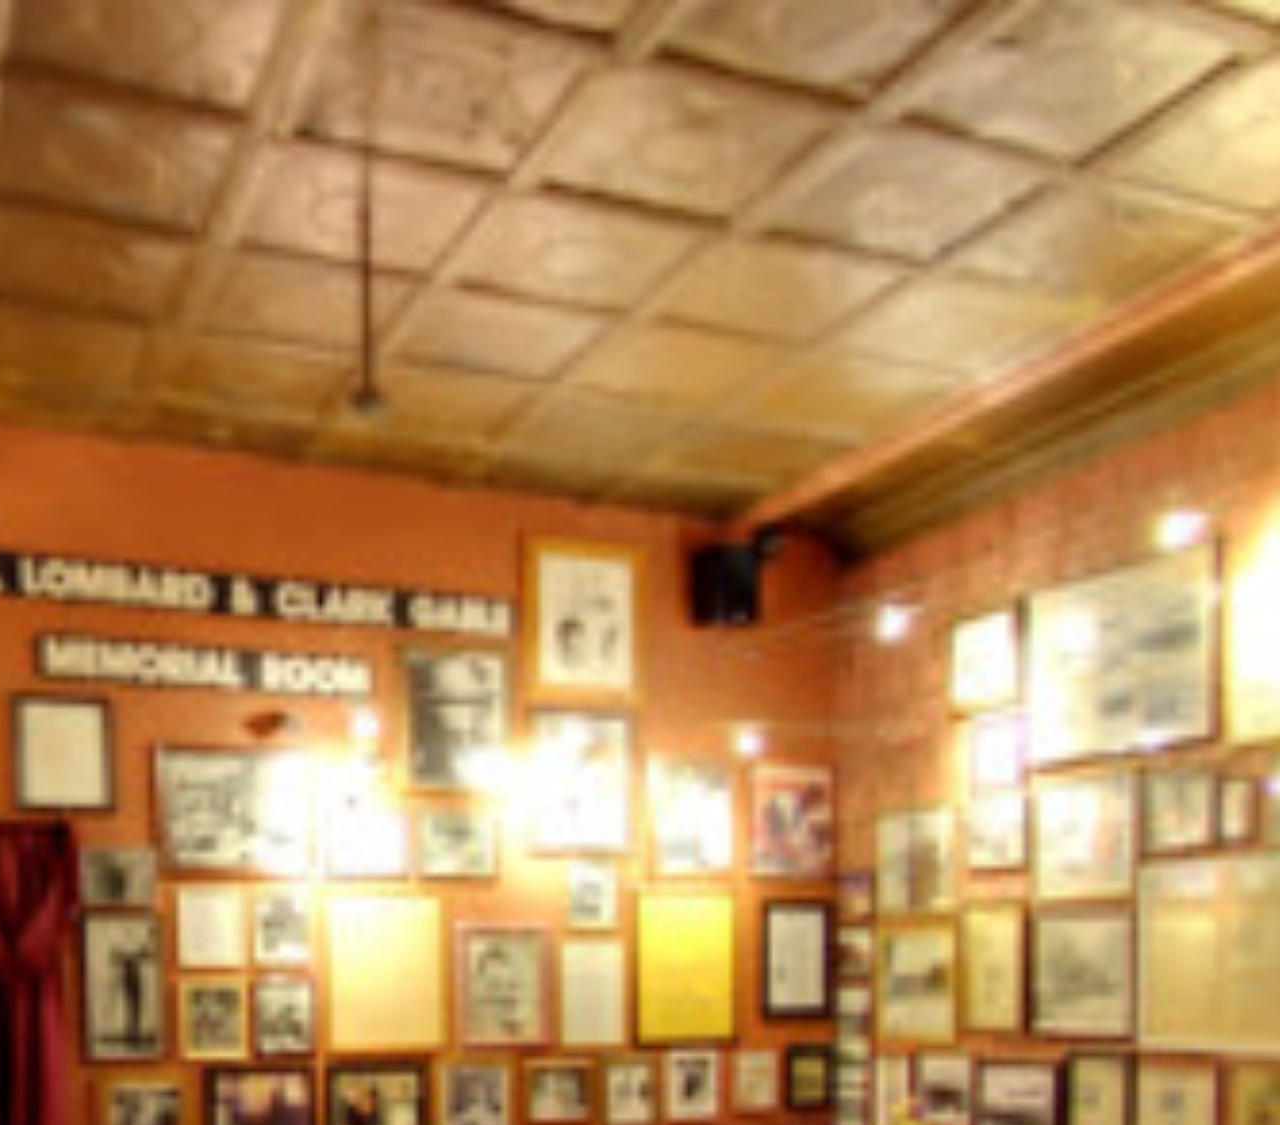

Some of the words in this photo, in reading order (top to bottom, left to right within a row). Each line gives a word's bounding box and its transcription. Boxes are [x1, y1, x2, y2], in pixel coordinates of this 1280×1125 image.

[21, 555, 211, 611] LOMBARD
[229, 574, 260, 614] &
[275, 580, 394, 625] CLARK
[45, 635, 243, 686] MEMORIAL
[261, 652, 371, 694] ROOM
